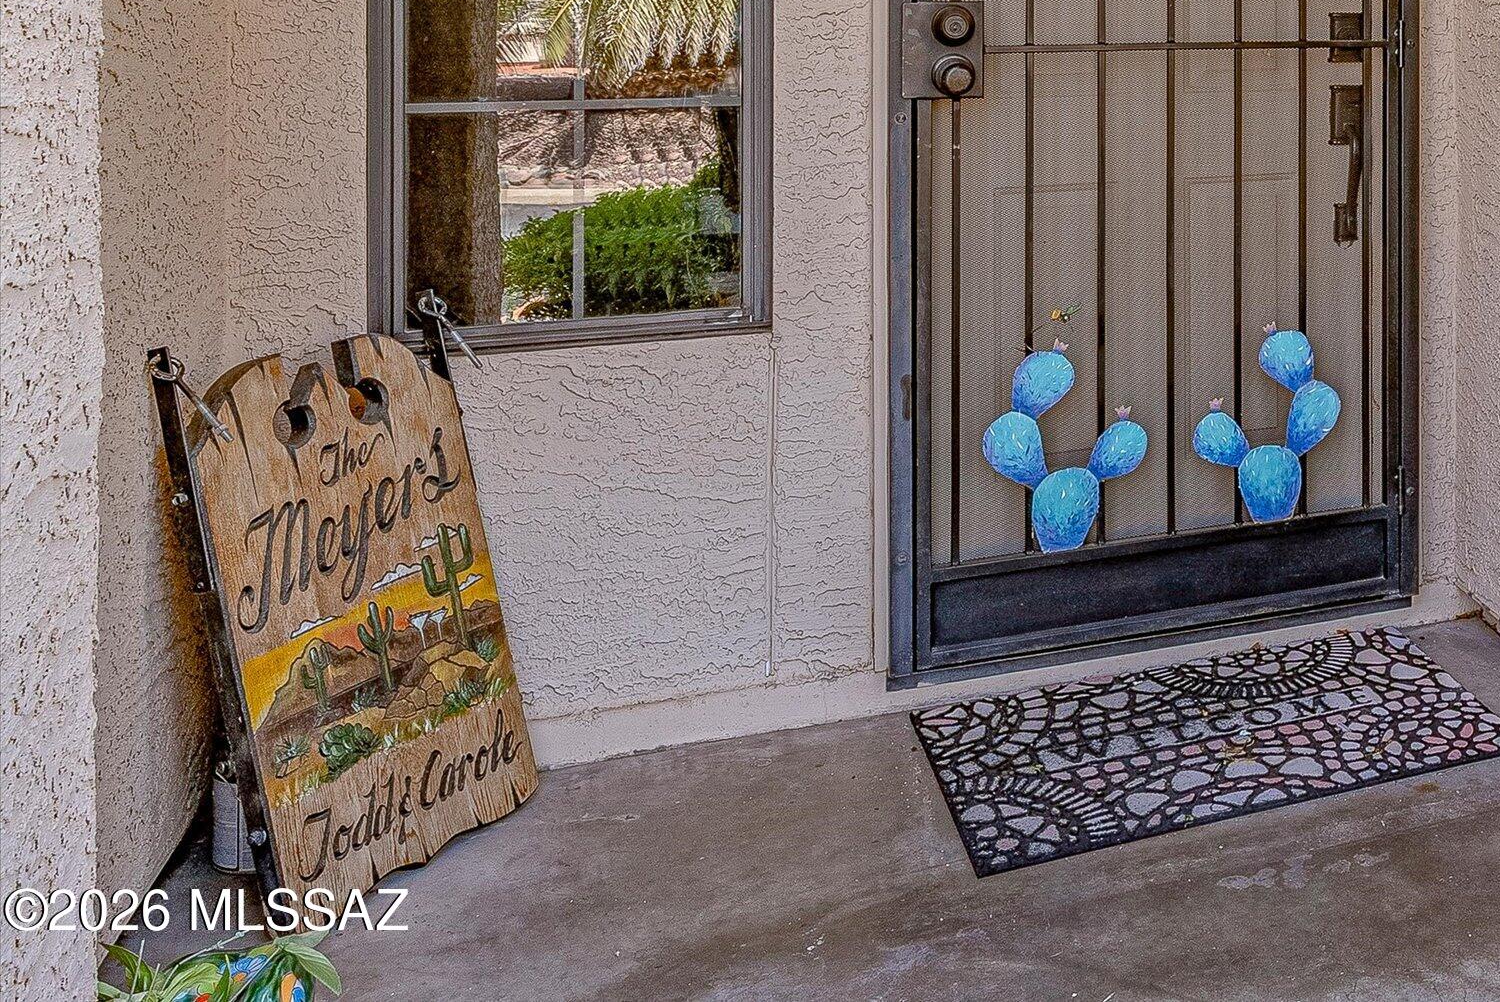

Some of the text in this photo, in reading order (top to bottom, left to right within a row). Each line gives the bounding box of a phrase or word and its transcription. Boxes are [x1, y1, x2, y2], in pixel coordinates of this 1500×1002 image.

[320, 426, 385, 487] The
[1050, 685, 1377, 766] WELCOME
[300, 771, 396, 883] Todd
[418, 708, 523, 811] Carole
